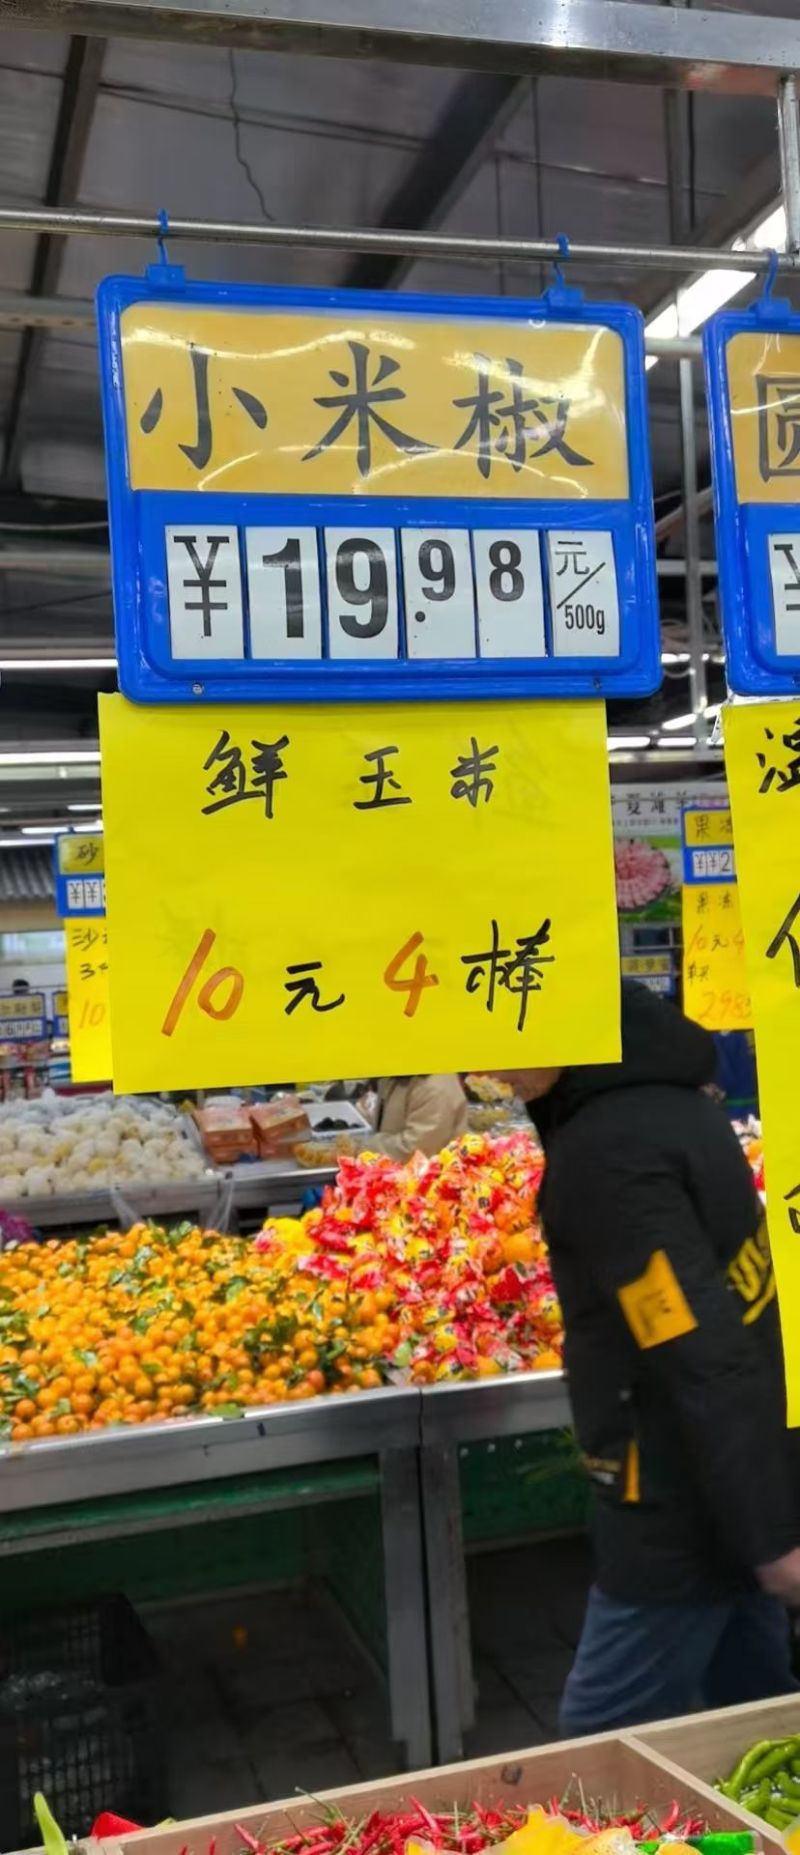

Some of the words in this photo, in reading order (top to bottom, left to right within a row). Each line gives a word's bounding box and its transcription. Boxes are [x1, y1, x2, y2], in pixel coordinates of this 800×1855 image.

[139, 338, 593, 480] 小米椒
[173, 533, 523, 641] ¥19.98
[201, 729, 500, 820] 鲜玉米
